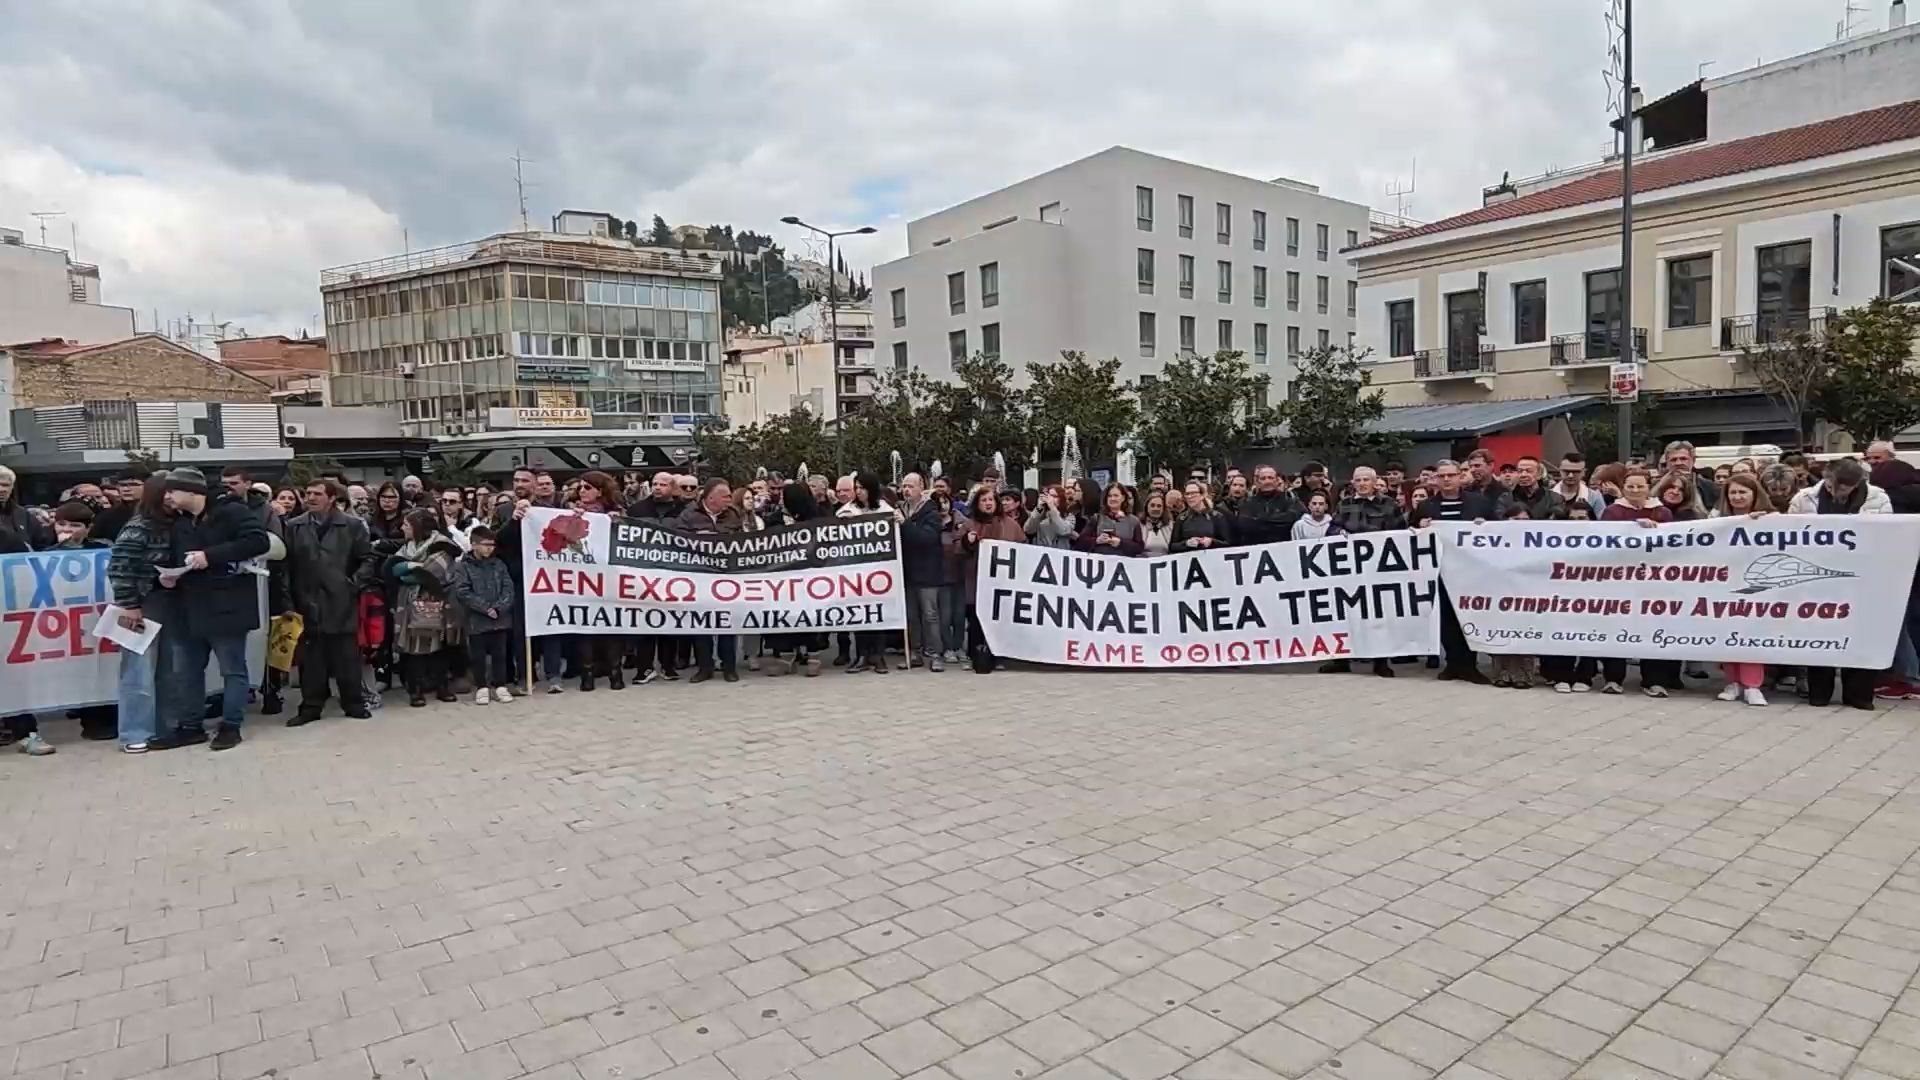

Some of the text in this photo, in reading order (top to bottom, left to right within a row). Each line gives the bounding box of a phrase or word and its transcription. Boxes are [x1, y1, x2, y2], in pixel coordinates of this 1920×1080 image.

[617, 520, 890, 555] ΕΡΓΑΤΟΥΠΑΛΛΗΛΙΚΟ ΚΕΝΤΡΟ
[1456, 525, 1857, 552] Γεν. Νοσοκομείο Λαμίας
[616, 541, 892, 568] ΠΕΡΙΦΕΡΕΙΑΚΗΣ ΕΝΟΤΗΤΑΣ ΦΘΙΩΤΙΔΑΣ
[989, 532, 1439, 593] Η ΔΙΨΑ ΓΙΑ ΤΑ ΚΕΡΔΗ
[529, 567, 893, 602] ΔΕΝ ΕΧΩ ΟΞΥΓΟΝΟ
[1550, 562, 1729, 583] Συμμετέχουμε
[546, 603, 884, 629] ΑΠΑΙΤΟΥΜΕ ΔΙΚΑΙΩΣΗ
[991, 580, 1437, 635] ΓΕΝΝΑΕΙ ΝΕΑ ΤΕΜΠΗ
[1458, 594, 1850, 620] και στηρίζουμε τον Αγώνα σας
[1066, 632, 1352, 664] ΕΛΜΕ ΦΘΙΩΤΙΔΑΣ
[1462, 622, 1481, 637] Οι
[1551, 629, 1608, 642] αυτές
[1652, 628, 1717, 649] βρουν
[1725, 632, 1850, 650] δικαίωση!
